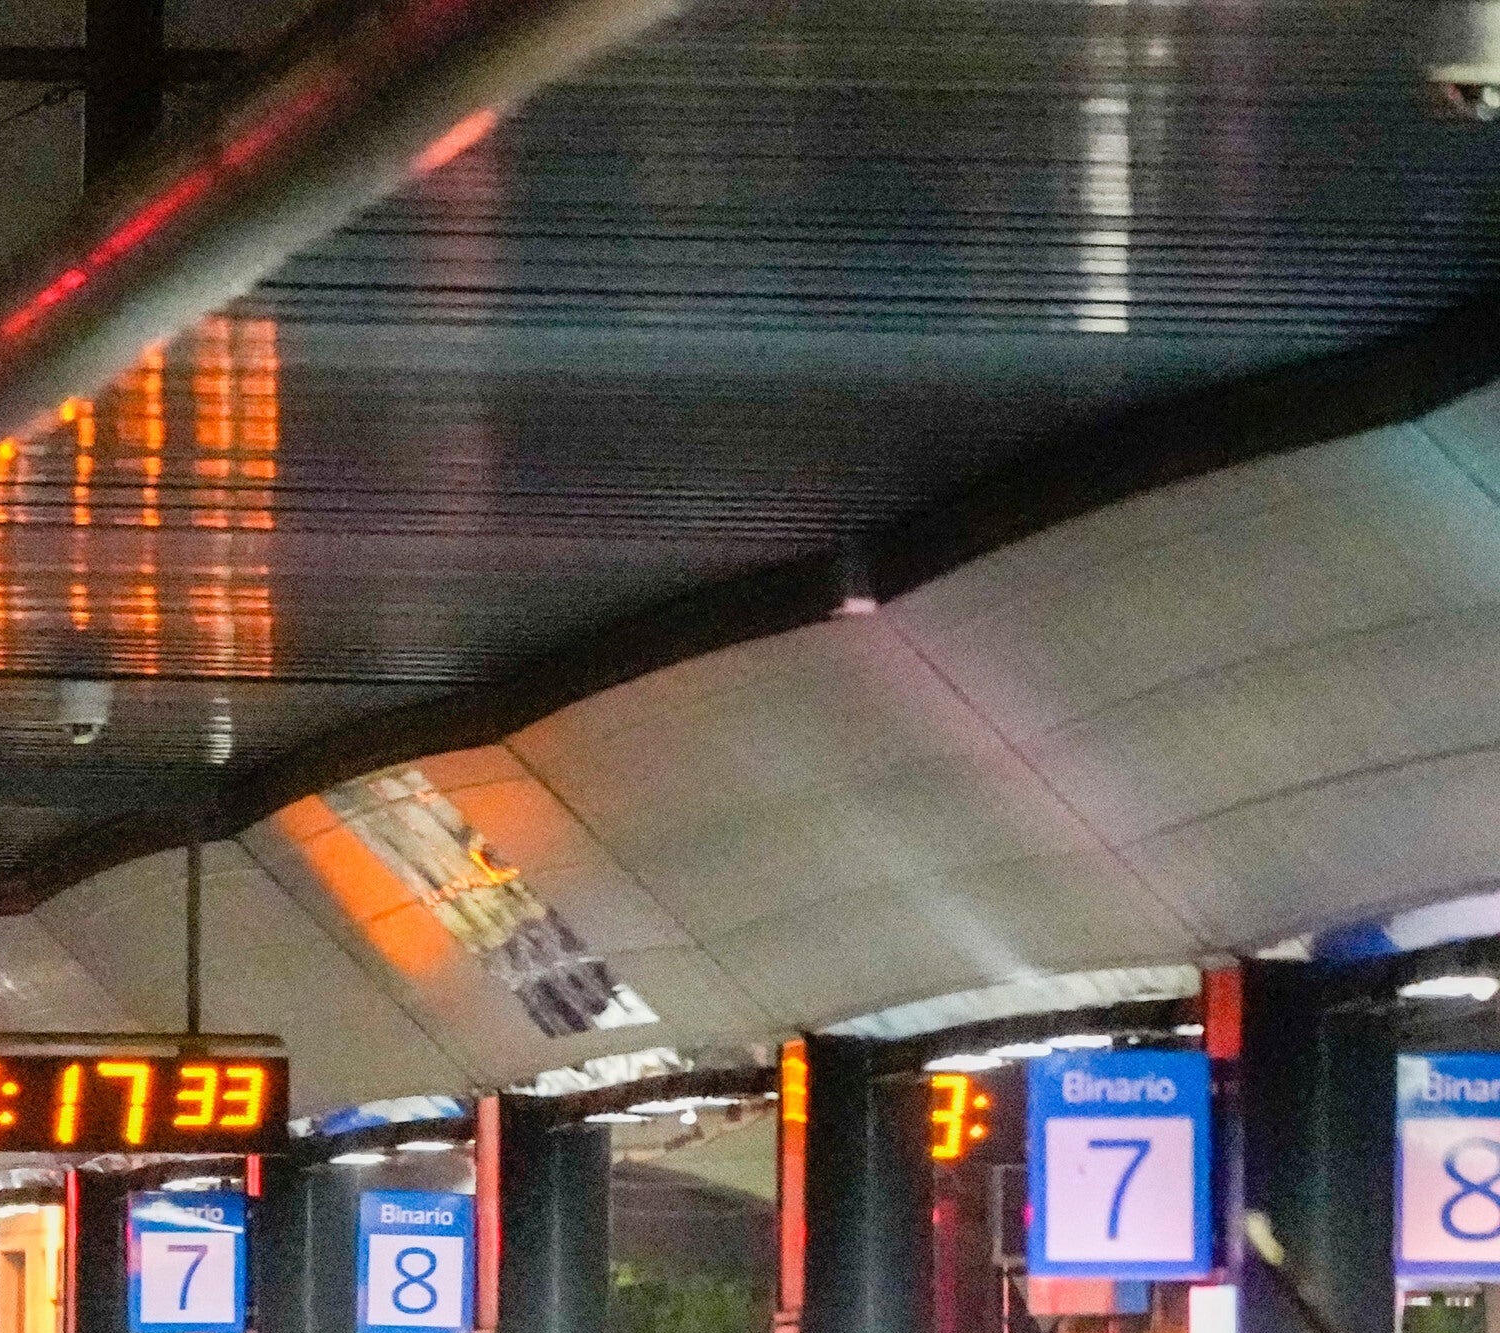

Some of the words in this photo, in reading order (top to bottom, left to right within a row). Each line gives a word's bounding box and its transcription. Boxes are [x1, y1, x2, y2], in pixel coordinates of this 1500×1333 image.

[174, 1067, 264, 1126] 33
[1063, 1069, 1177, 1103] Binario
[380, 1204, 454, 1226] Binario
[1089, 1139, 1150, 1239] 7
[1441, 1136, 1500, 1240] 8
[168, 1244, 208, 1310] 7
[392, 1246, 438, 1315] 8
